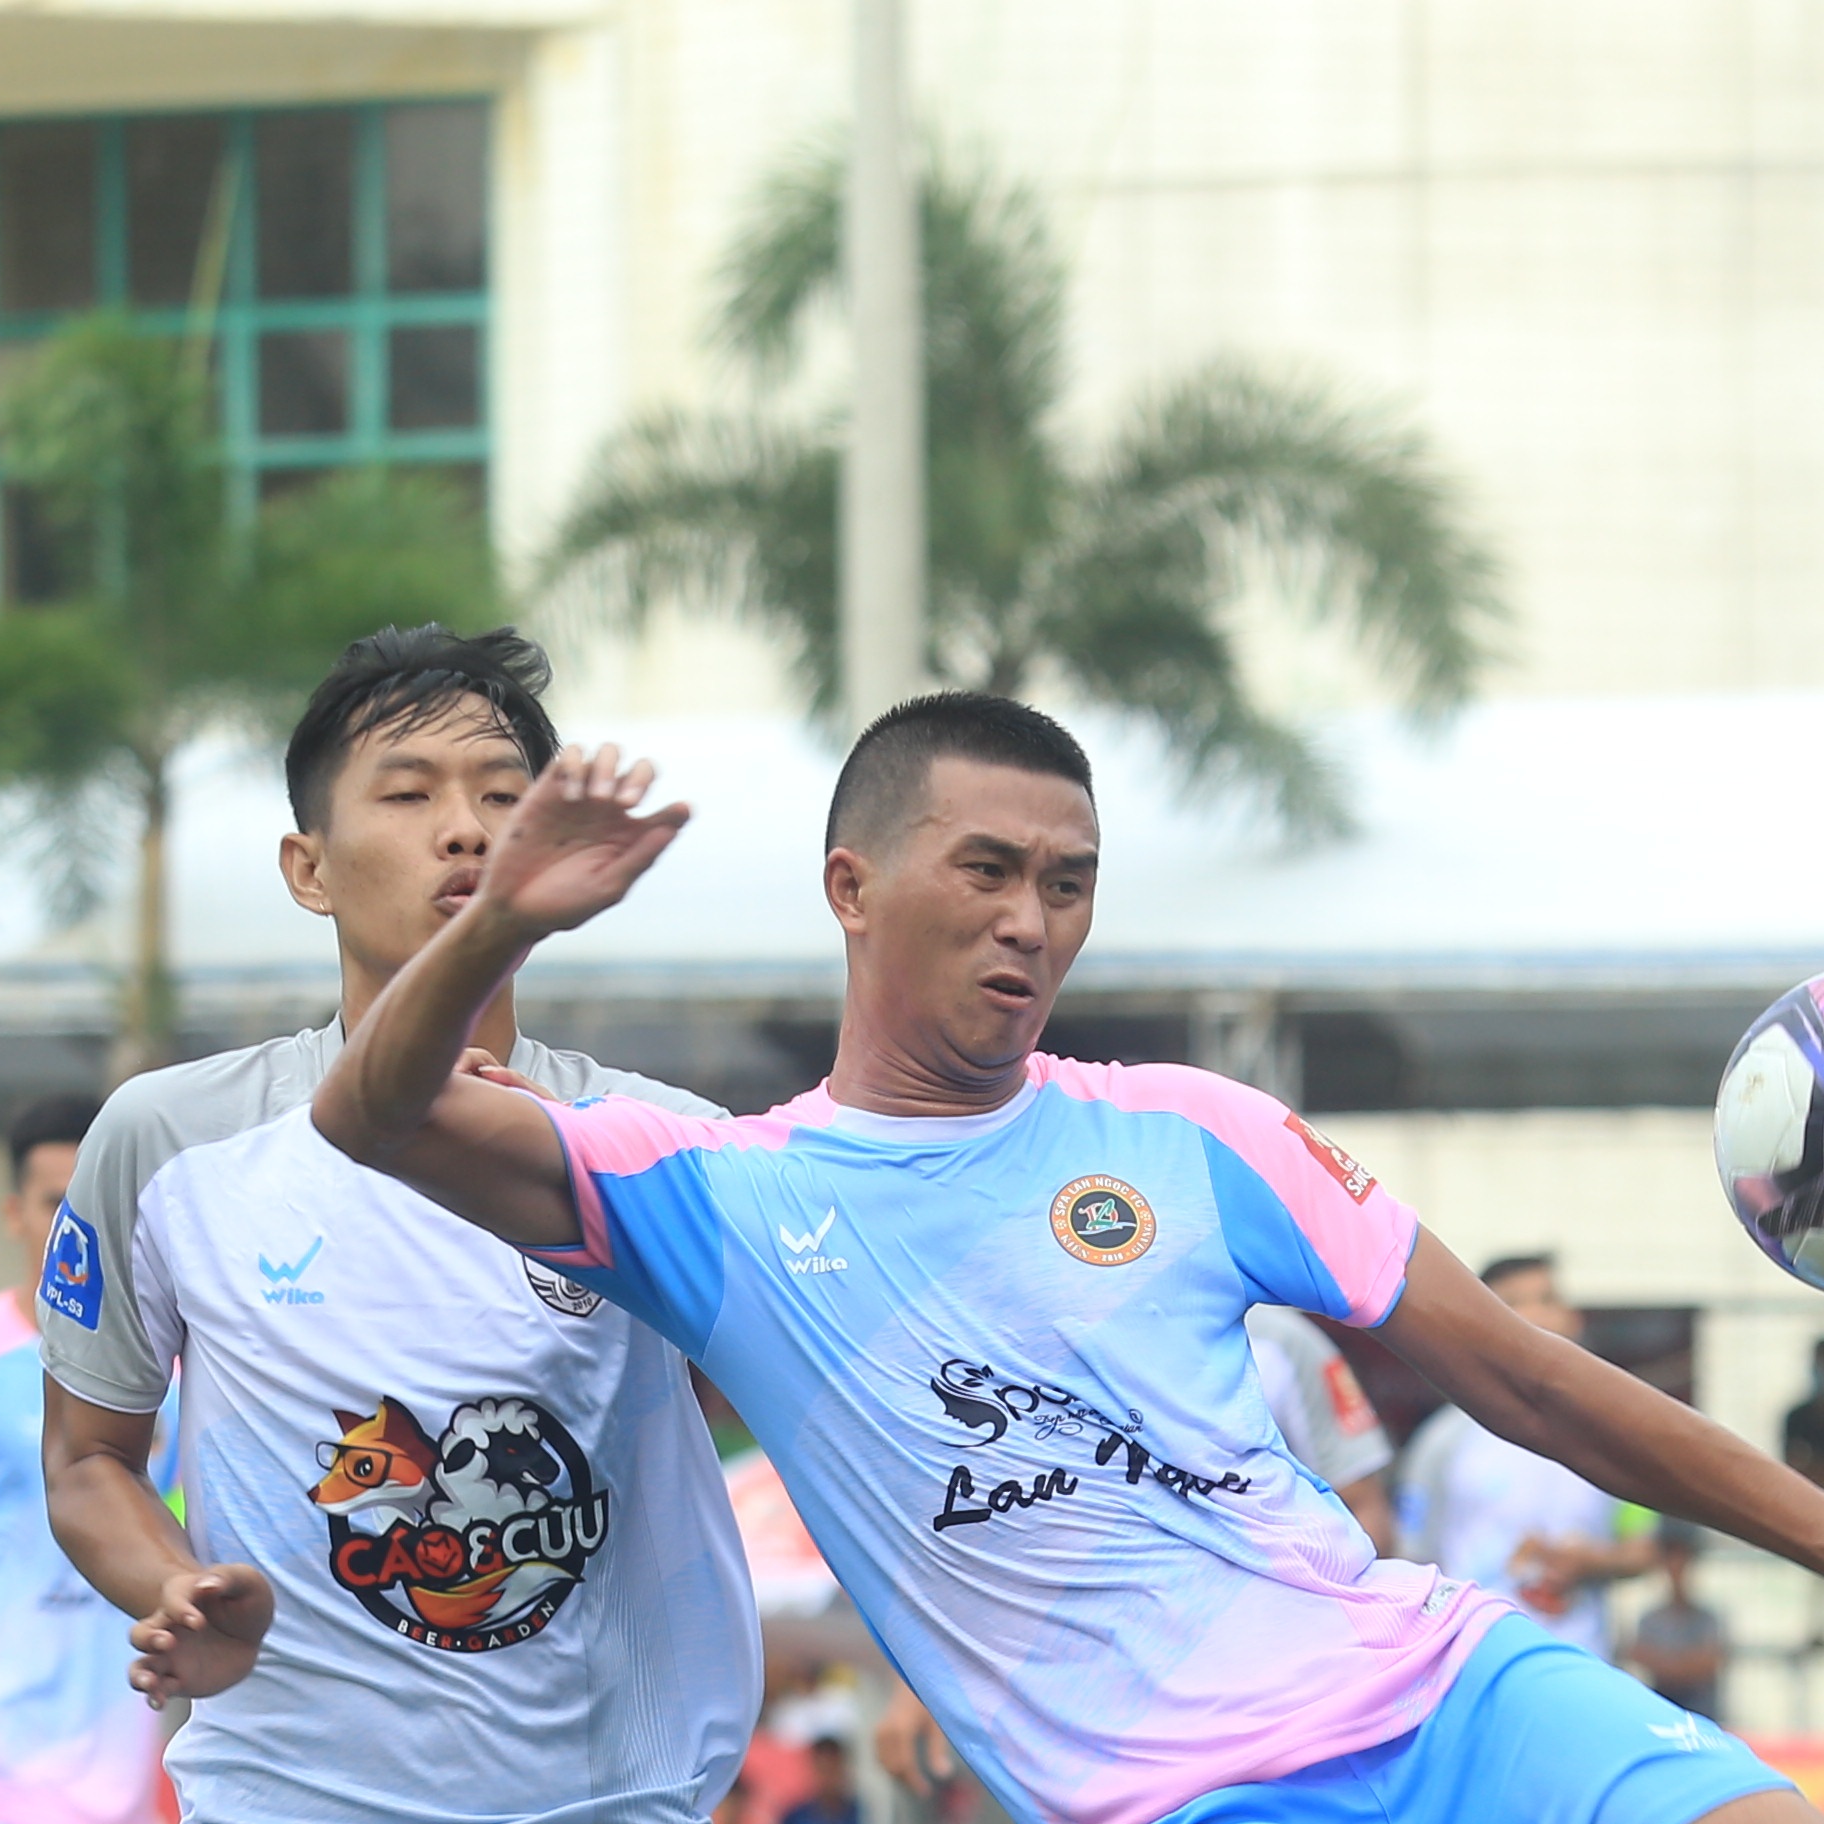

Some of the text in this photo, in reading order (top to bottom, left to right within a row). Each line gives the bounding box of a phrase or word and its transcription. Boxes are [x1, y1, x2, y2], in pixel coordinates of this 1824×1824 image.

[1055, 1195, 1071, 1216] SPA
[1067, 1179, 1091, 1194] LAN
[1130, 1194, 1145, 1208] FC
[785, 1256, 848, 1275] Wika
[46, 1282, 84, 1318] VPL-S3
[260, 1288, 325, 1305] Wika
[934, 1465, 1079, 1532] Lan
[397, 1601, 555, 1651] BEER GARDEN
